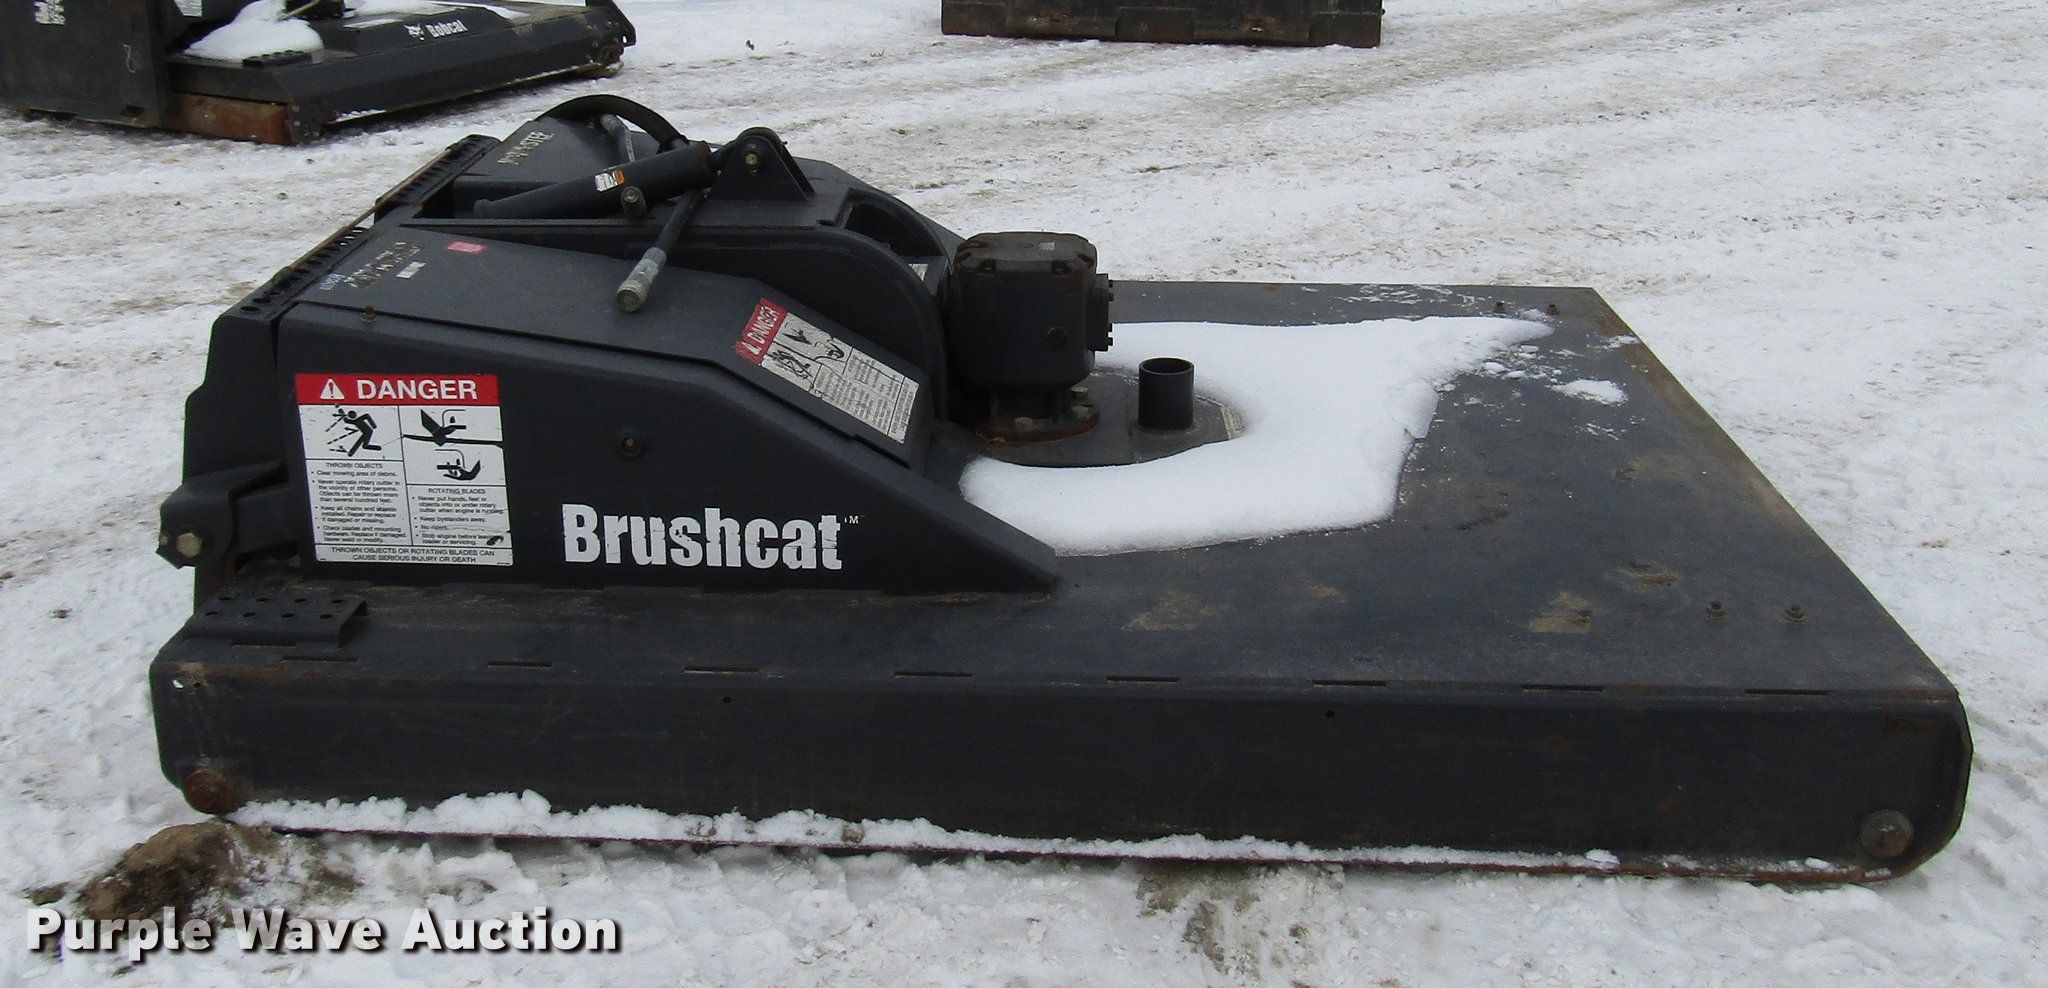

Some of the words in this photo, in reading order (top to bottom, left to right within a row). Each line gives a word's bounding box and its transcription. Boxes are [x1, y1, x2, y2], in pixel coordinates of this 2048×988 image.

[425, 19, 468, 38] Bobcat
[747, 305, 781, 345] DANGER
[356, 379, 478, 400] DANGER
[562, 504, 842, 570] Brushcat
